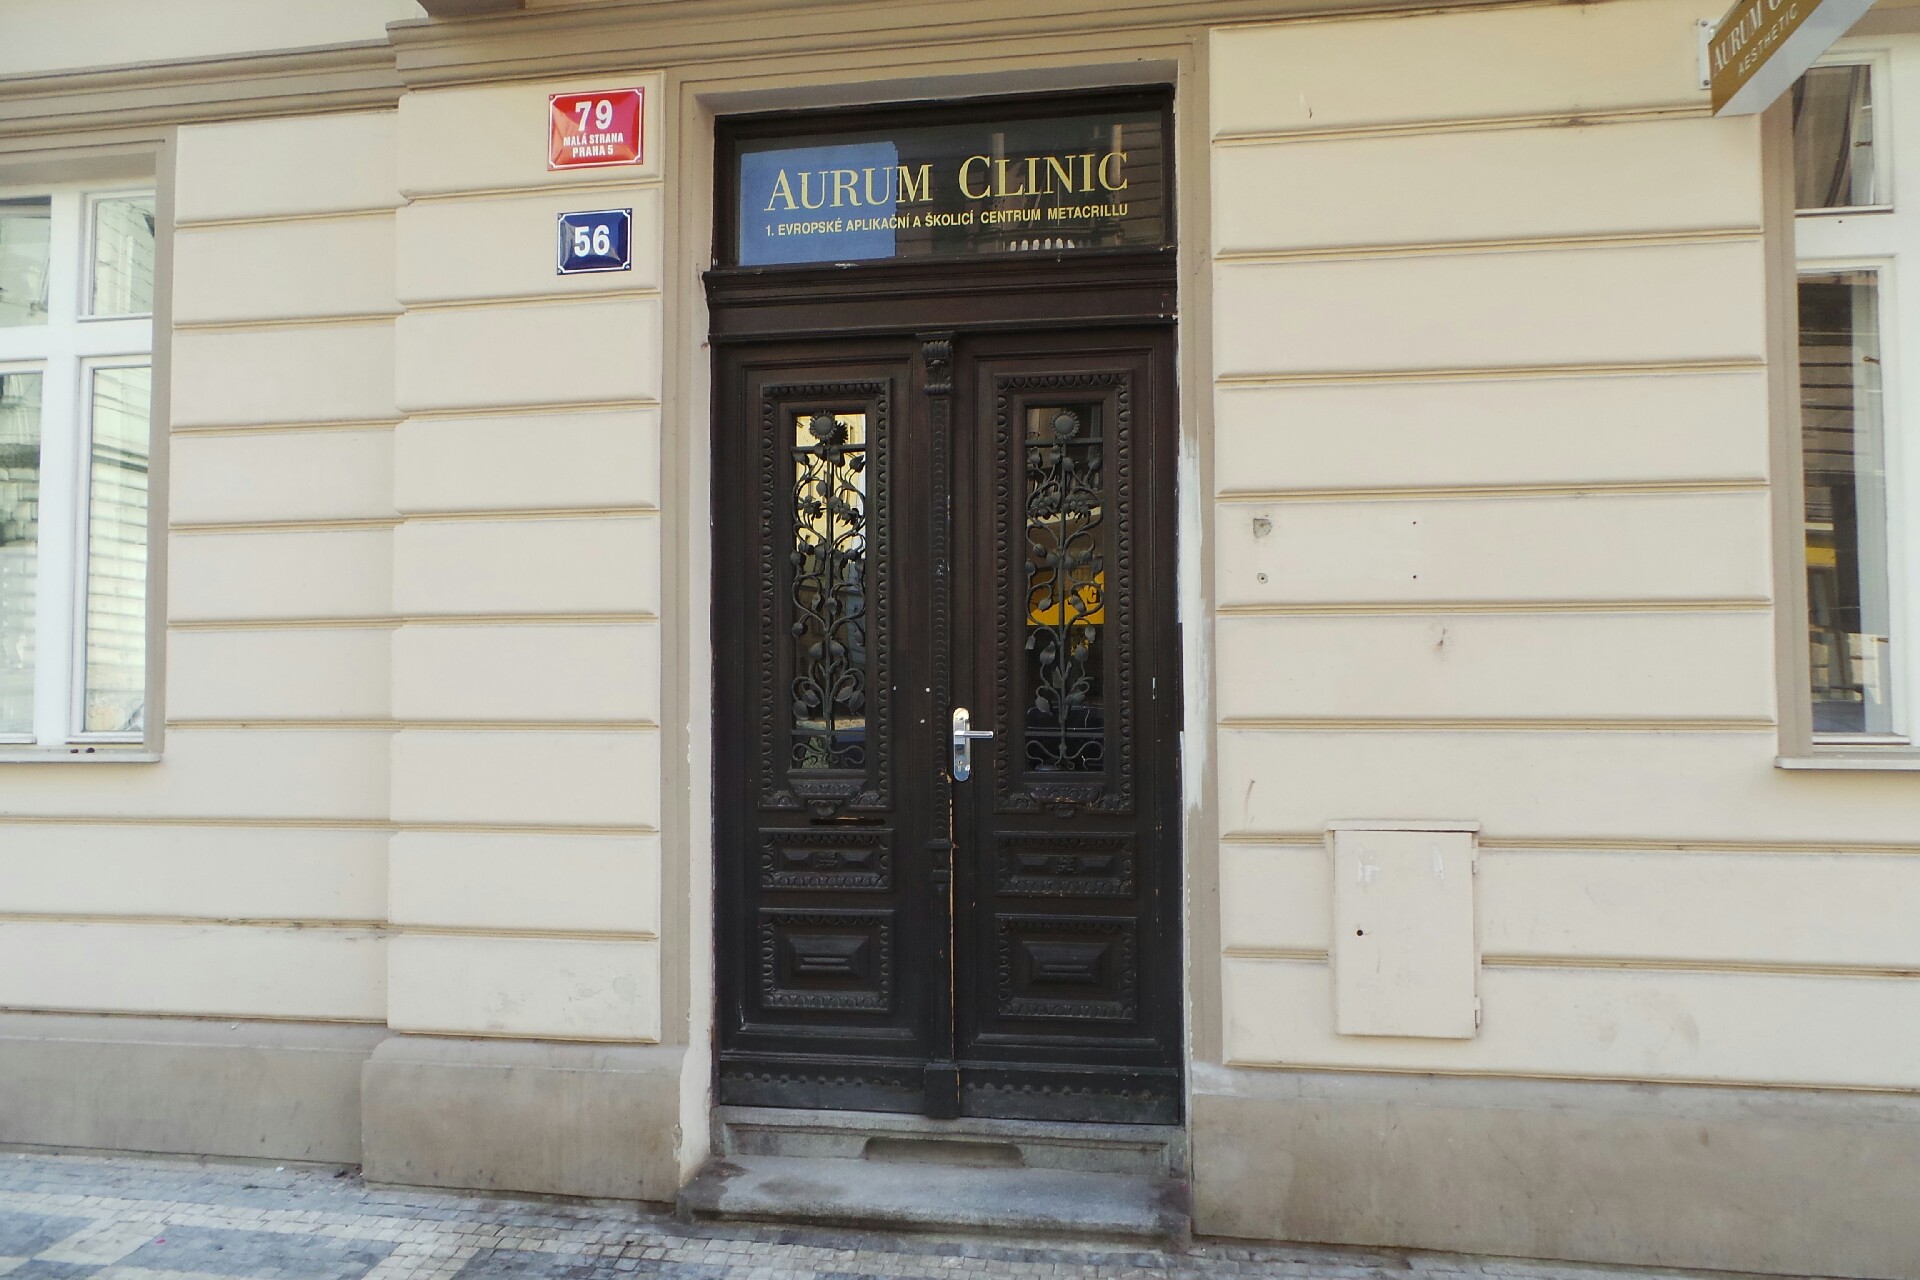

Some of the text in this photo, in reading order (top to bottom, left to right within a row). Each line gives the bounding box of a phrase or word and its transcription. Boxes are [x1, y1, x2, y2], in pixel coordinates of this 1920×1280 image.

[1714, 0, 1763, 76] AURUM
[1739, 3, 1799, 76] AESTHETIC
[575, 99, 613, 132] 79
[563, 132, 624, 146] MALÁ STRANA
[572, 145, 613, 158] PRAHA 5
[763, 152, 1128, 212] AURUM CLINIC
[765, 203, 1128, 237] 1. EVROPSKÉ APLIKAČNÍ A ŠKOLICÍ CENTRUM METACRILLU
[574, 224, 610, 258] 56
